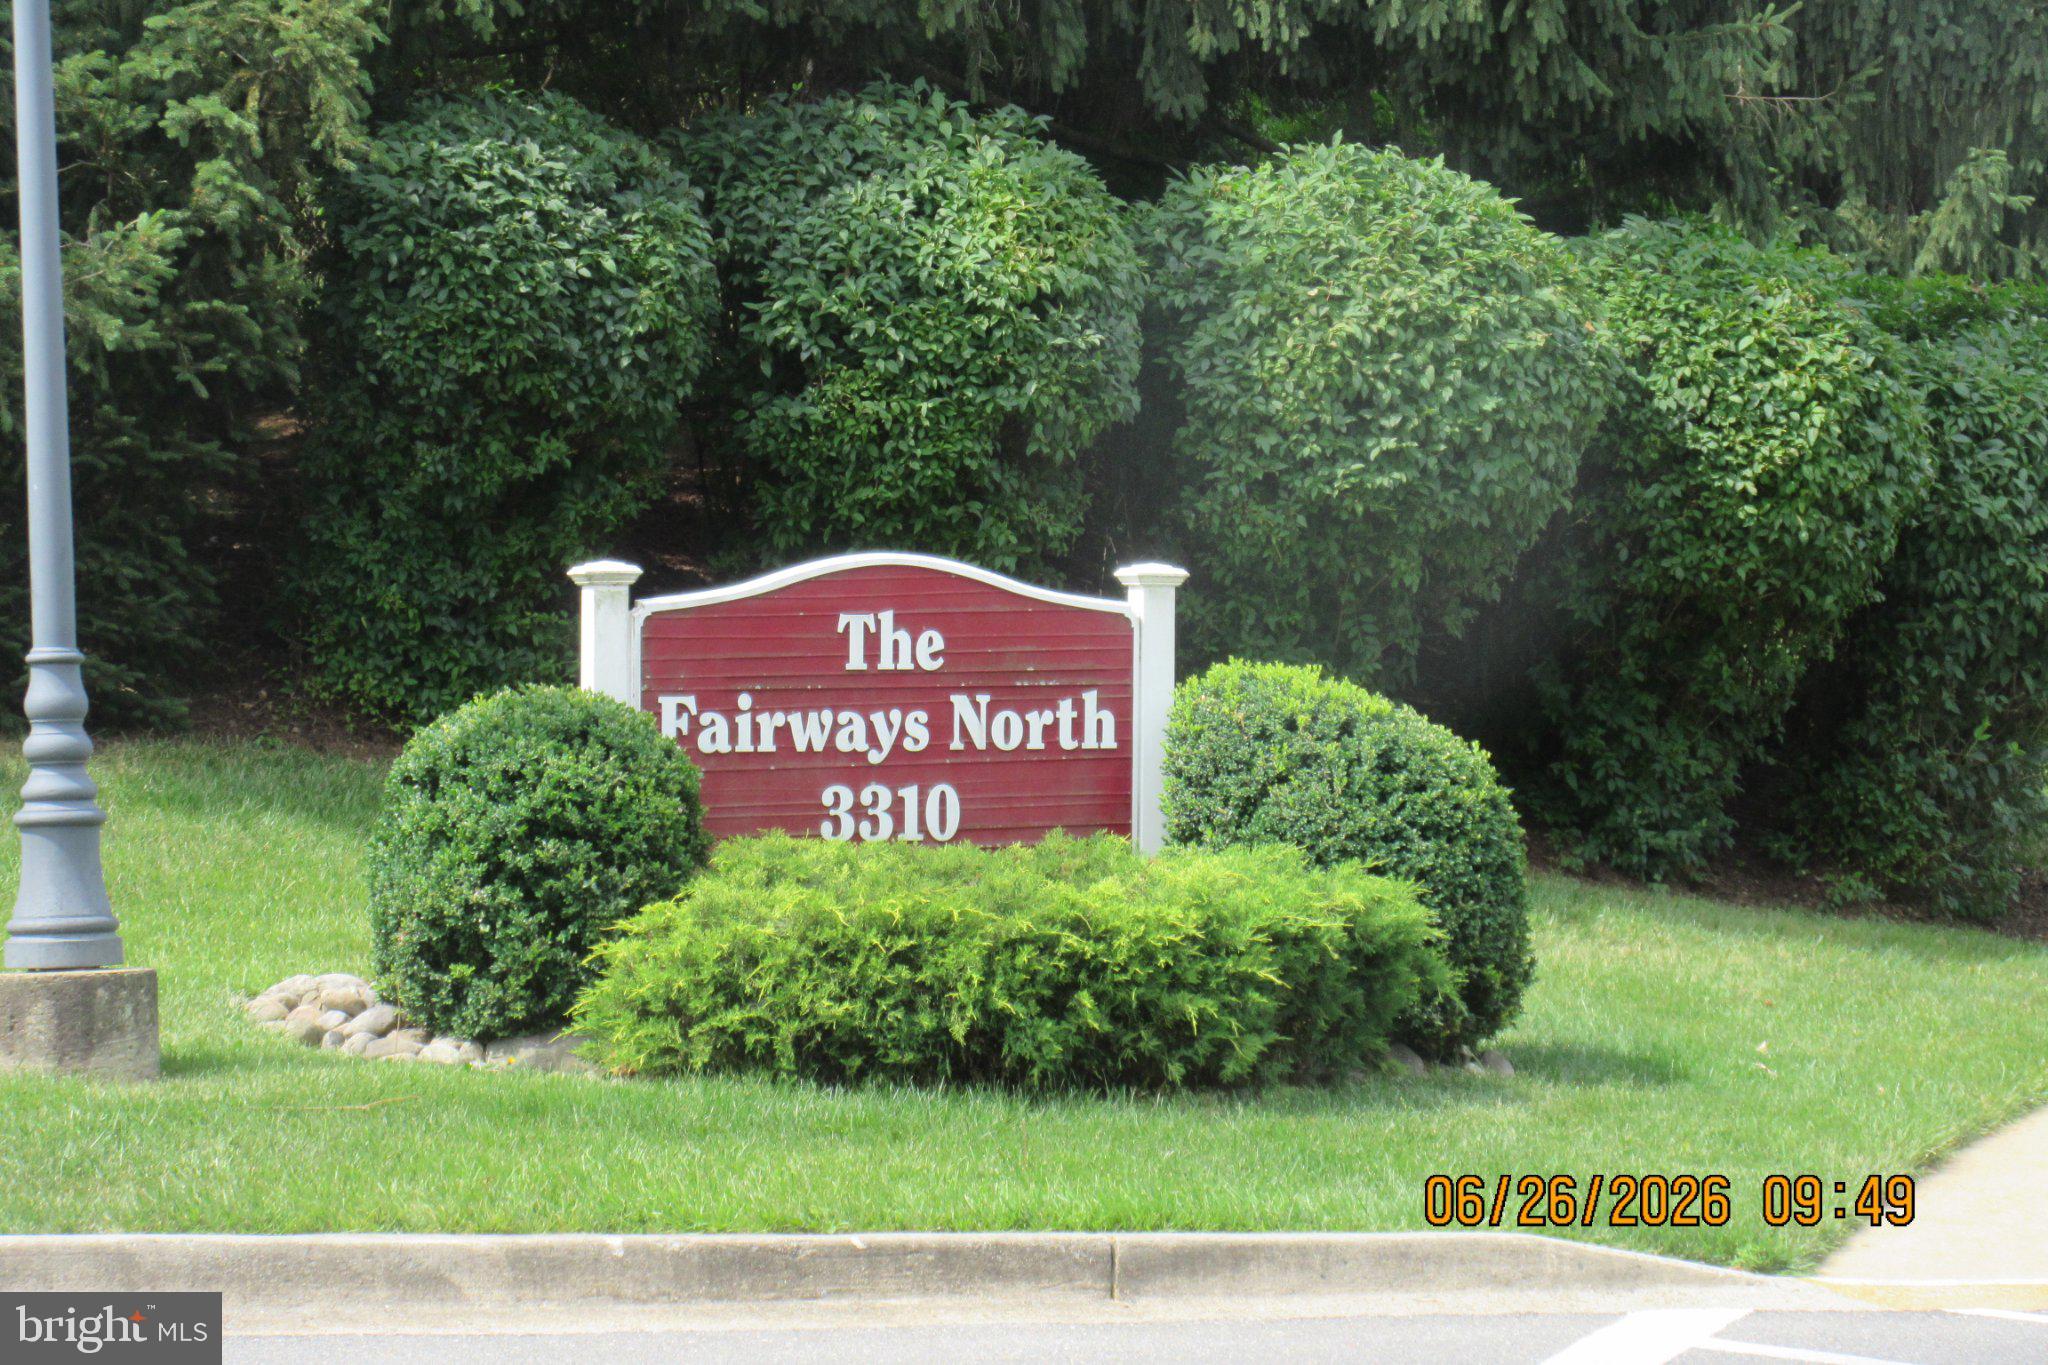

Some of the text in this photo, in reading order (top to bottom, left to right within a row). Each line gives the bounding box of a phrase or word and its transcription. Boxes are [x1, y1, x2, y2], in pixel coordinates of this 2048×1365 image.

[837, 609, 945, 672] The
[657, 689, 1118, 764] Fairways North
[820, 783, 961, 843] 3310
